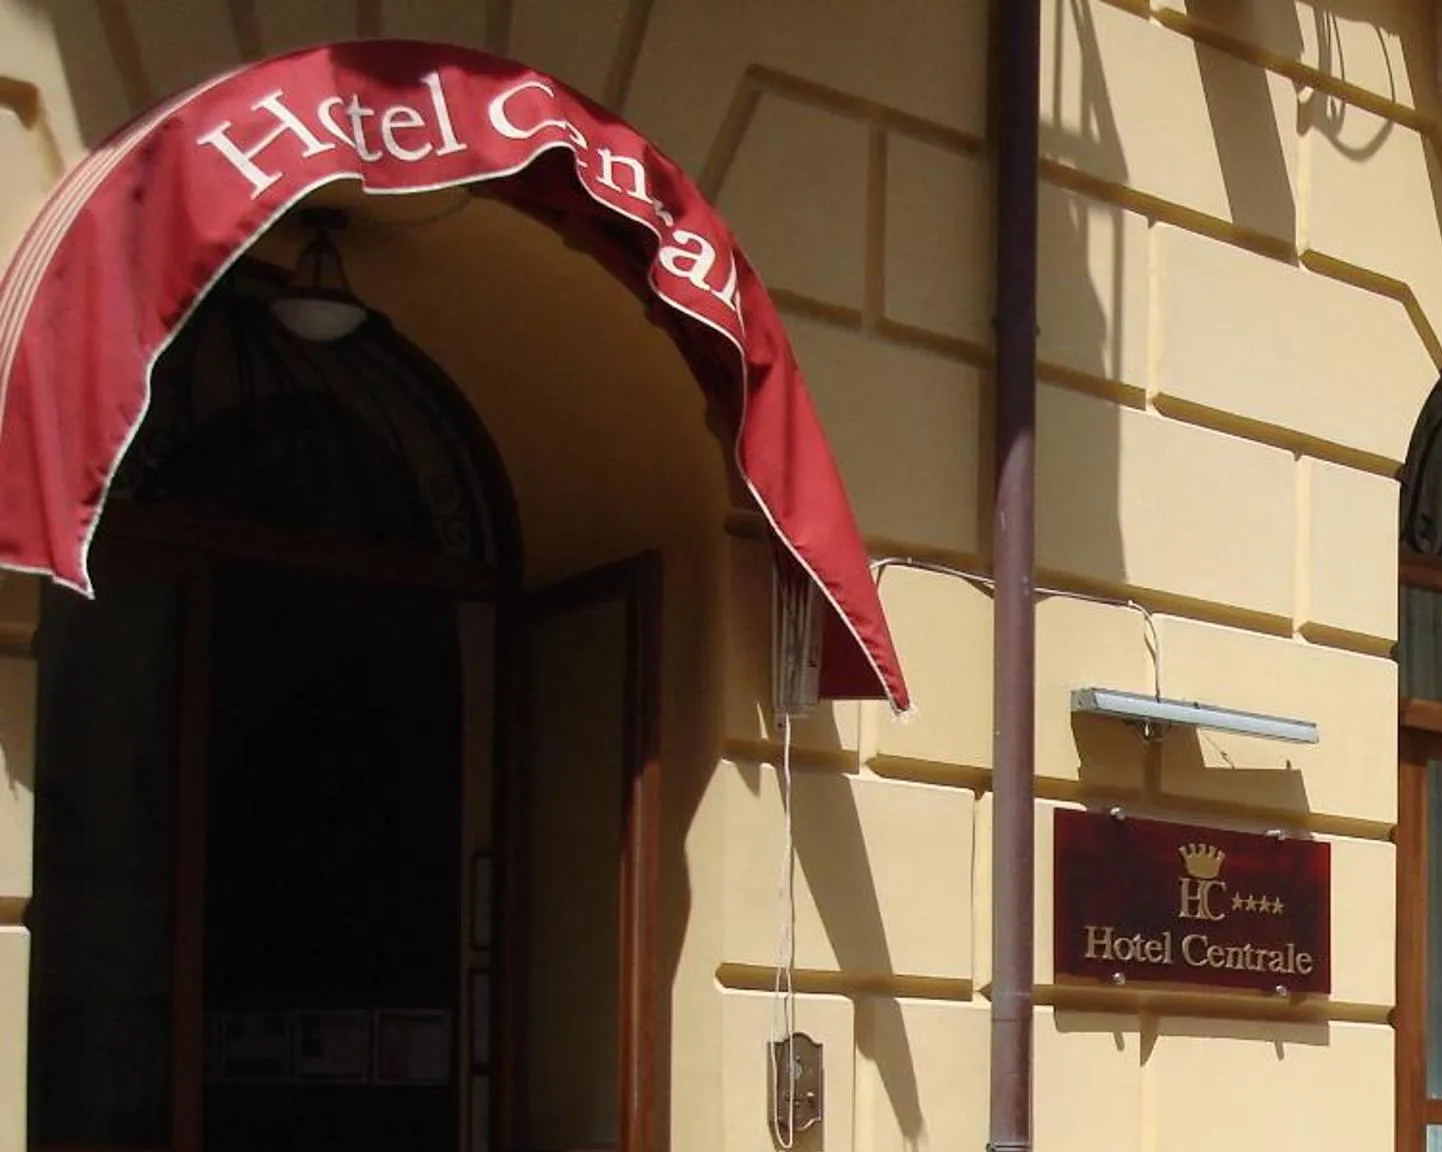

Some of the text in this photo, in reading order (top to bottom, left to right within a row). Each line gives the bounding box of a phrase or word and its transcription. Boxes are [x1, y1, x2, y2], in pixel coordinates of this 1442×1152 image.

[1177, 877, 1227, 921] HC
[1084, 925, 1314, 974] Hotel Centrale
